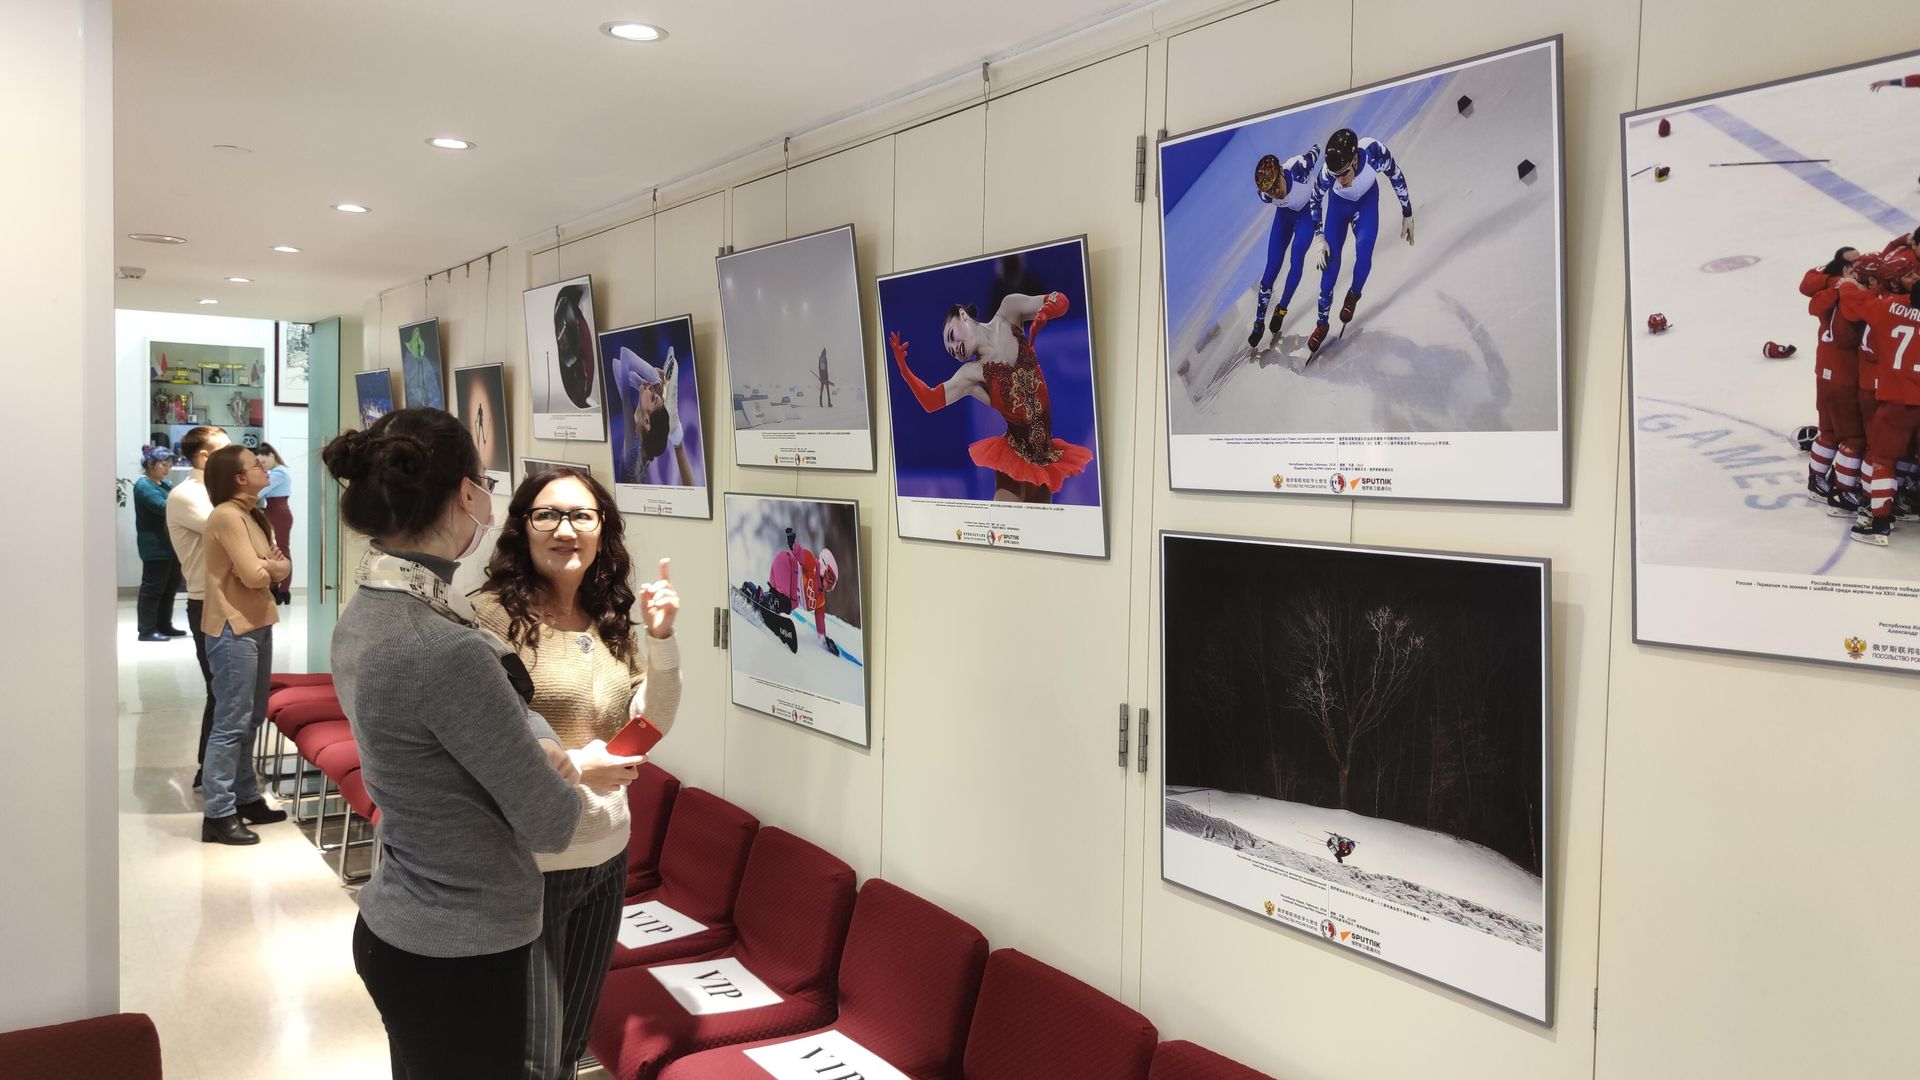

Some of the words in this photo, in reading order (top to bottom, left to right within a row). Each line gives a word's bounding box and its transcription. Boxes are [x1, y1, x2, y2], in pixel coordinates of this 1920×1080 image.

[1638, 413, 1819, 511] GAMES
[1872, 652, 1910, 662] ПОСОЛЬСТВО
[624, 911, 673, 933] VIP
[1351, 932, 1381, 949] SPUTNIK
[693, 970, 742, 998] VIP
